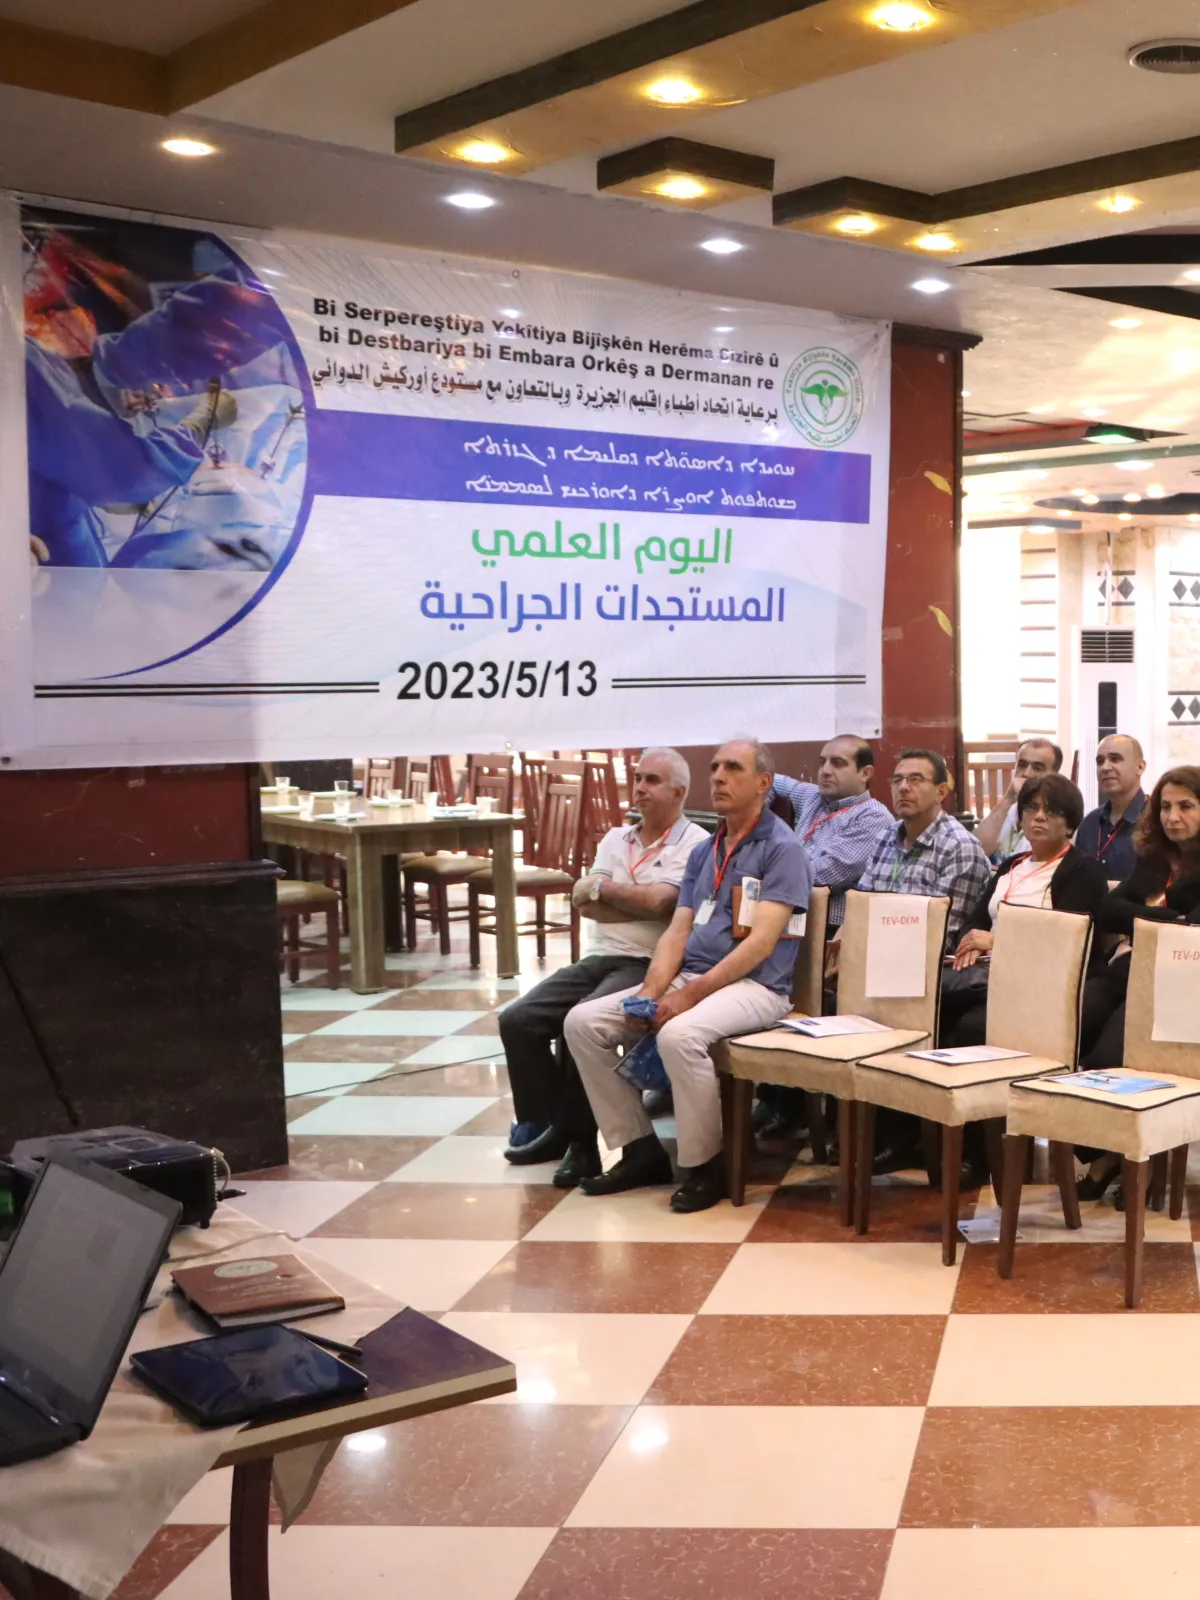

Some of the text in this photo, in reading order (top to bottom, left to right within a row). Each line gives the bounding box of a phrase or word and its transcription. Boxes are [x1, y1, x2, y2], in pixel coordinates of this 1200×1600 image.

[313, 297, 336, 316] Bi
[344, 301, 485, 336] Serpereştiya
[491, 319, 567, 346] Yekîtiya
[572, 329, 643, 353] Bijîşkên
[648, 339, 714, 361] Herêma
[769, 352, 780, 369] û
[312, 357, 370, 388] الدوائي
[319, 325, 775, 391] bi Destbariya bi Embara Orkêş a Dermanan re
[431, 370, 483, 396] مستودع
[486, 379, 502, 403] مع
[505, 375, 572, 407] وبالتعاون
[576, 384, 627, 409] الجزيرة
[702, 397, 734, 417] اتحاد
[737, 398, 779, 426] برعاية
[471, 520, 733, 574] اليوم العلمي
[419, 580, 785, 633] المستجدات الجراحية
[396, 659, 599, 701] 2023/5/13
[881, 915, 919, 926] TEV-DEM
